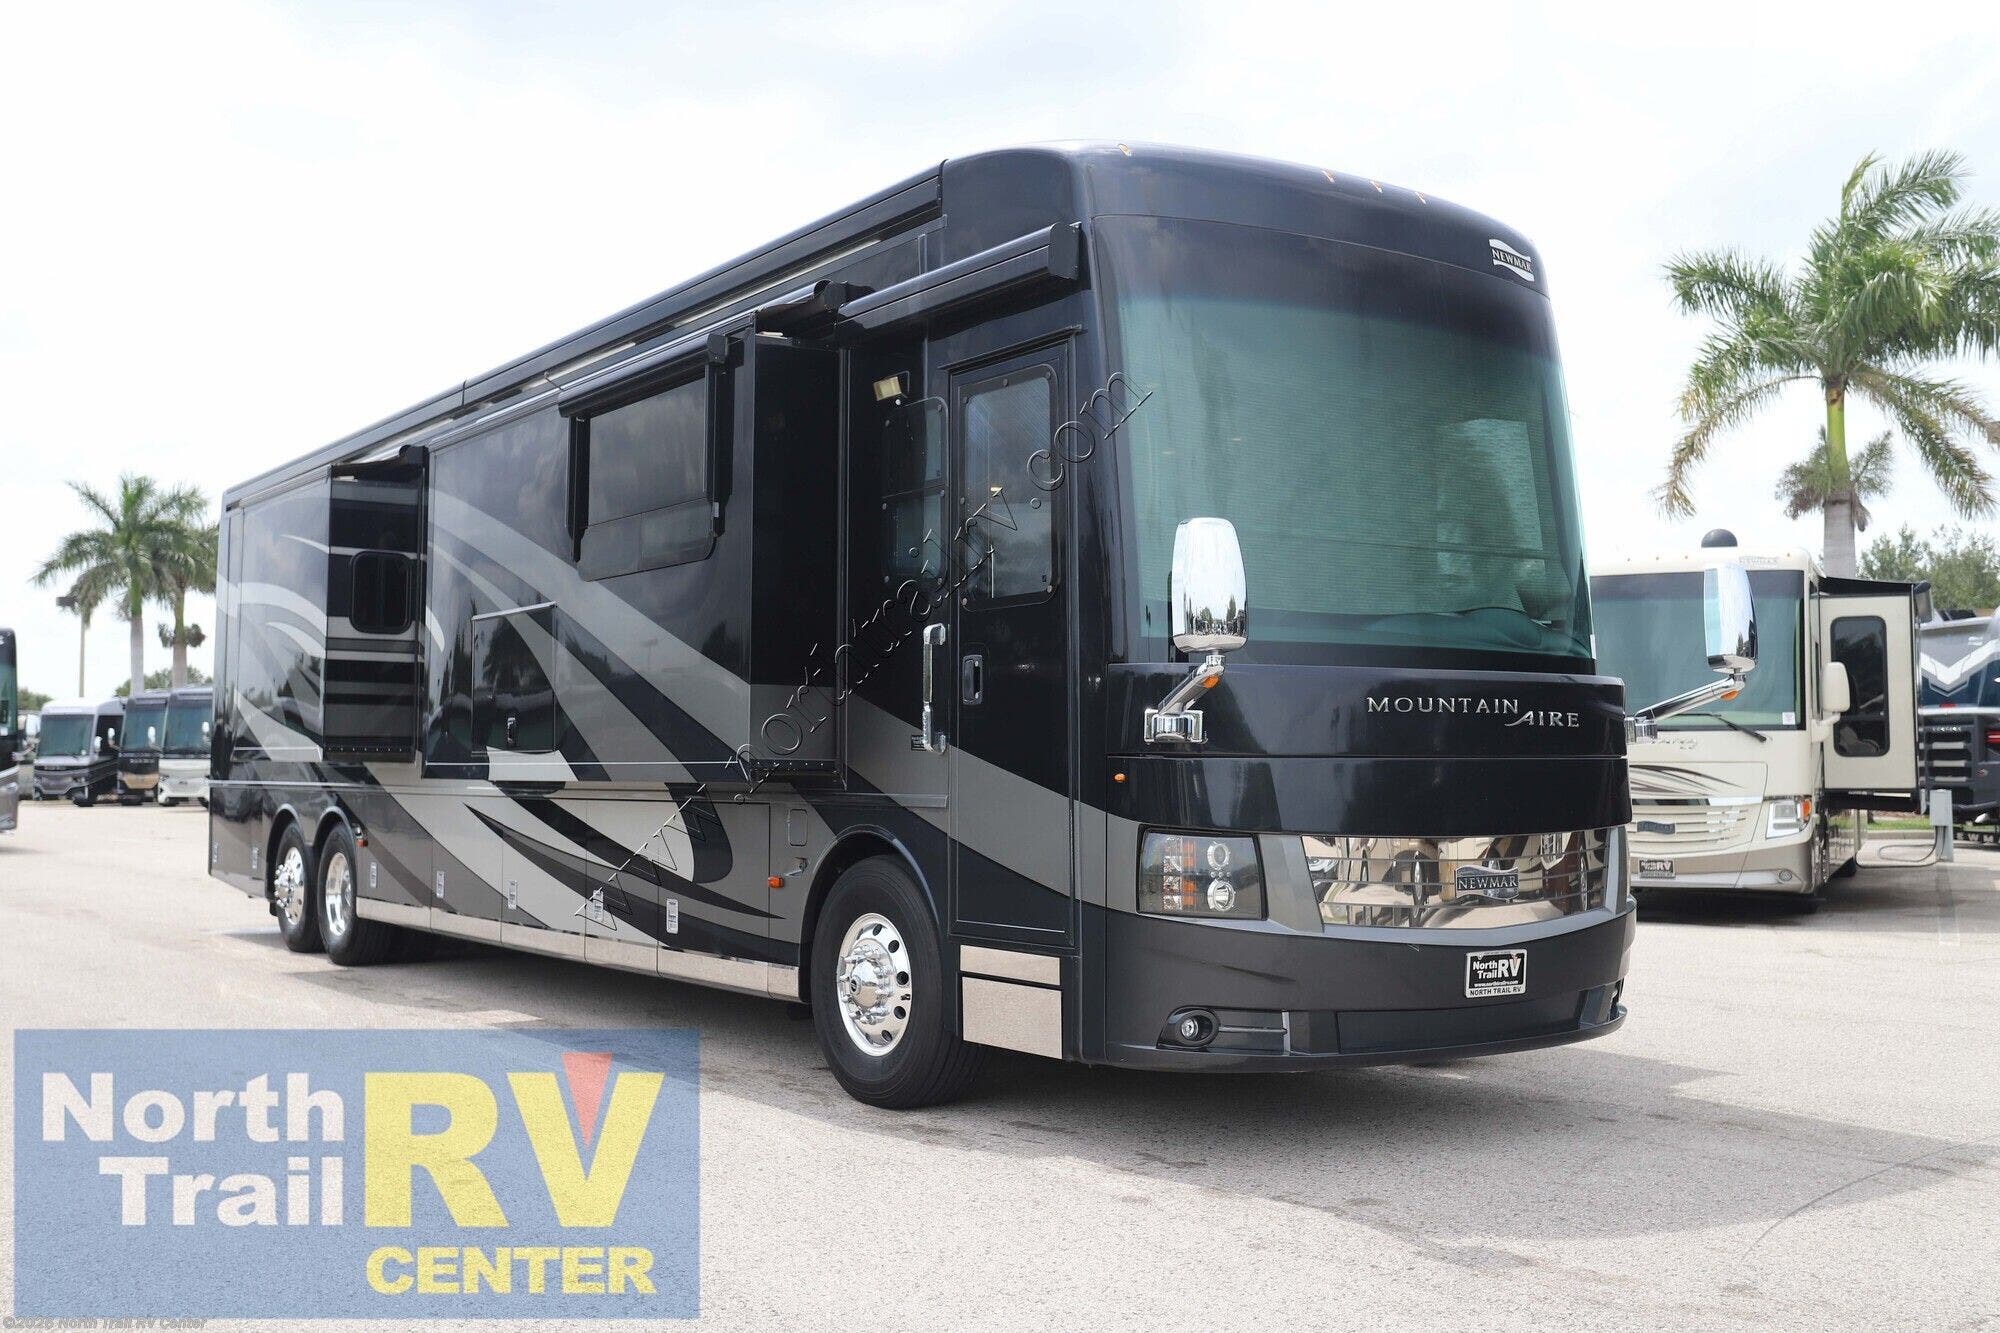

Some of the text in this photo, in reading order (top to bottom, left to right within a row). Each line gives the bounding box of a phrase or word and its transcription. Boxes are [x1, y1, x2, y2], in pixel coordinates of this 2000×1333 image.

[1492, 248, 1532, 272] NEWMAR
[1367, 697, 1580, 728] MOUNTAIN AIRE
[1458, 875, 1517, 889] NEWMAR
[1473, 960, 1497, 970] North
[1498, 958, 1521, 978] RV
[1477, 970, 1497, 979] Trail
[1470, 988, 1491, 996] NORTH
